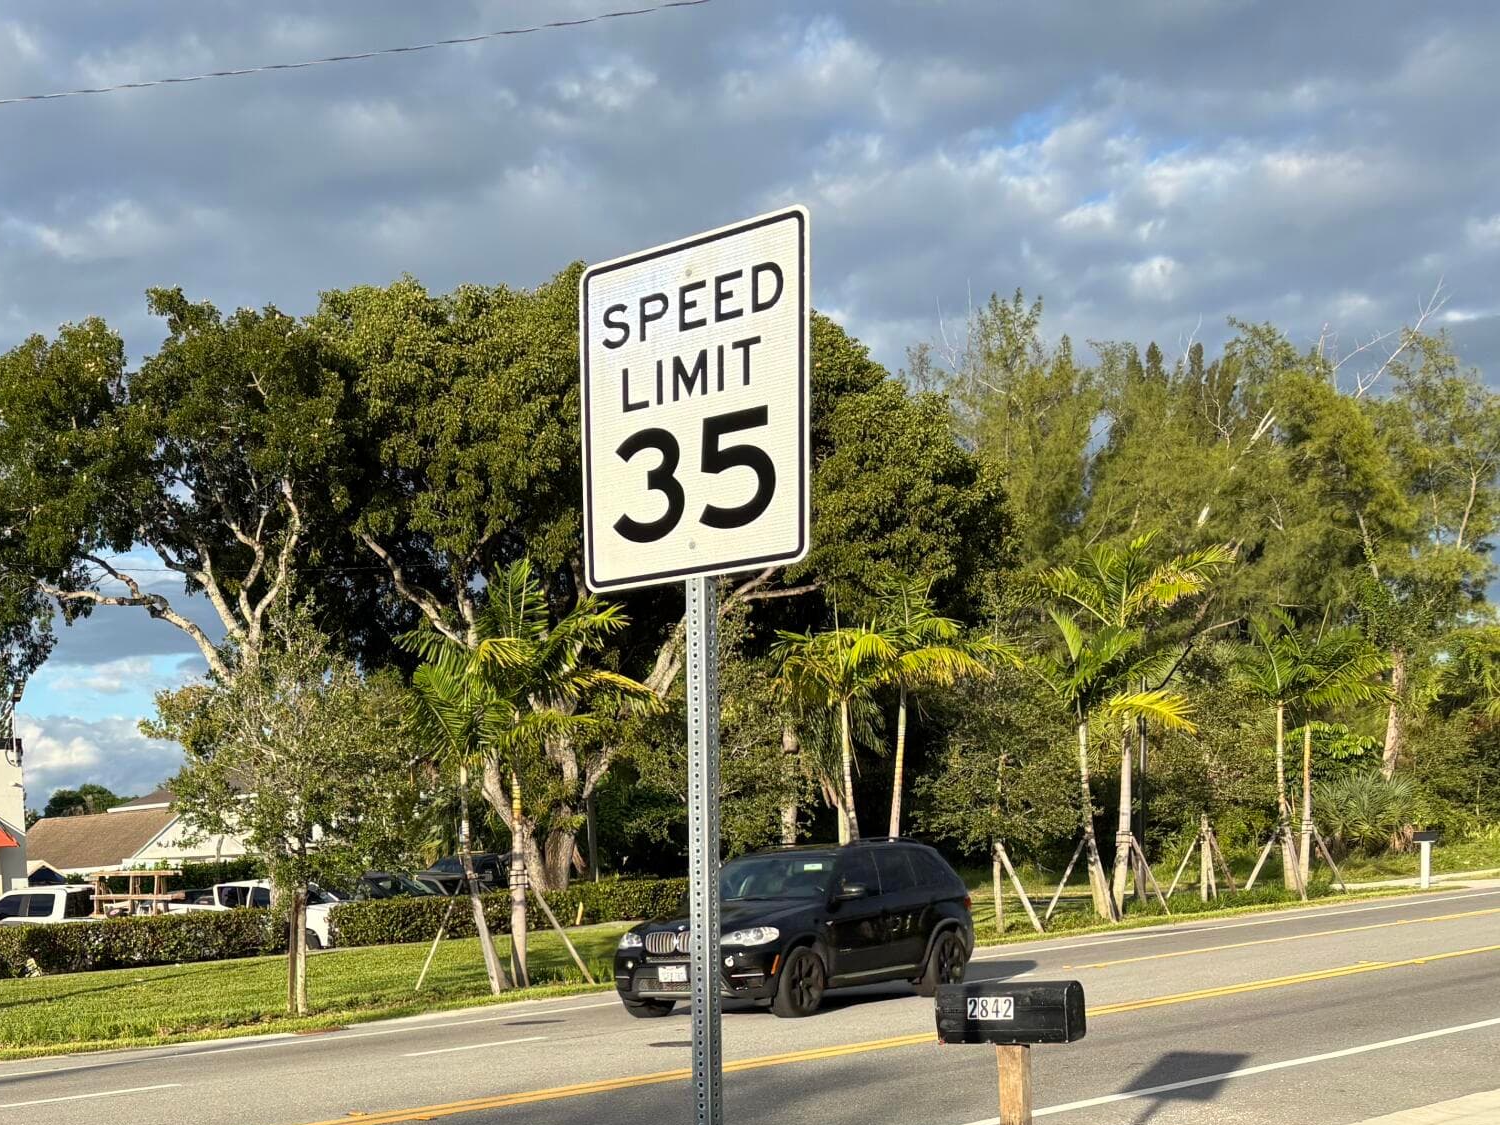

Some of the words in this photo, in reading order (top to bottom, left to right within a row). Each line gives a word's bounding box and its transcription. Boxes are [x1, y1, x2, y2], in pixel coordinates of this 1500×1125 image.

[602, 261, 784, 349] SPEED
[622, 335, 761, 413] LIMIT
[613, 405, 776, 543] 35
[968, 998, 1012, 1018] 2842
